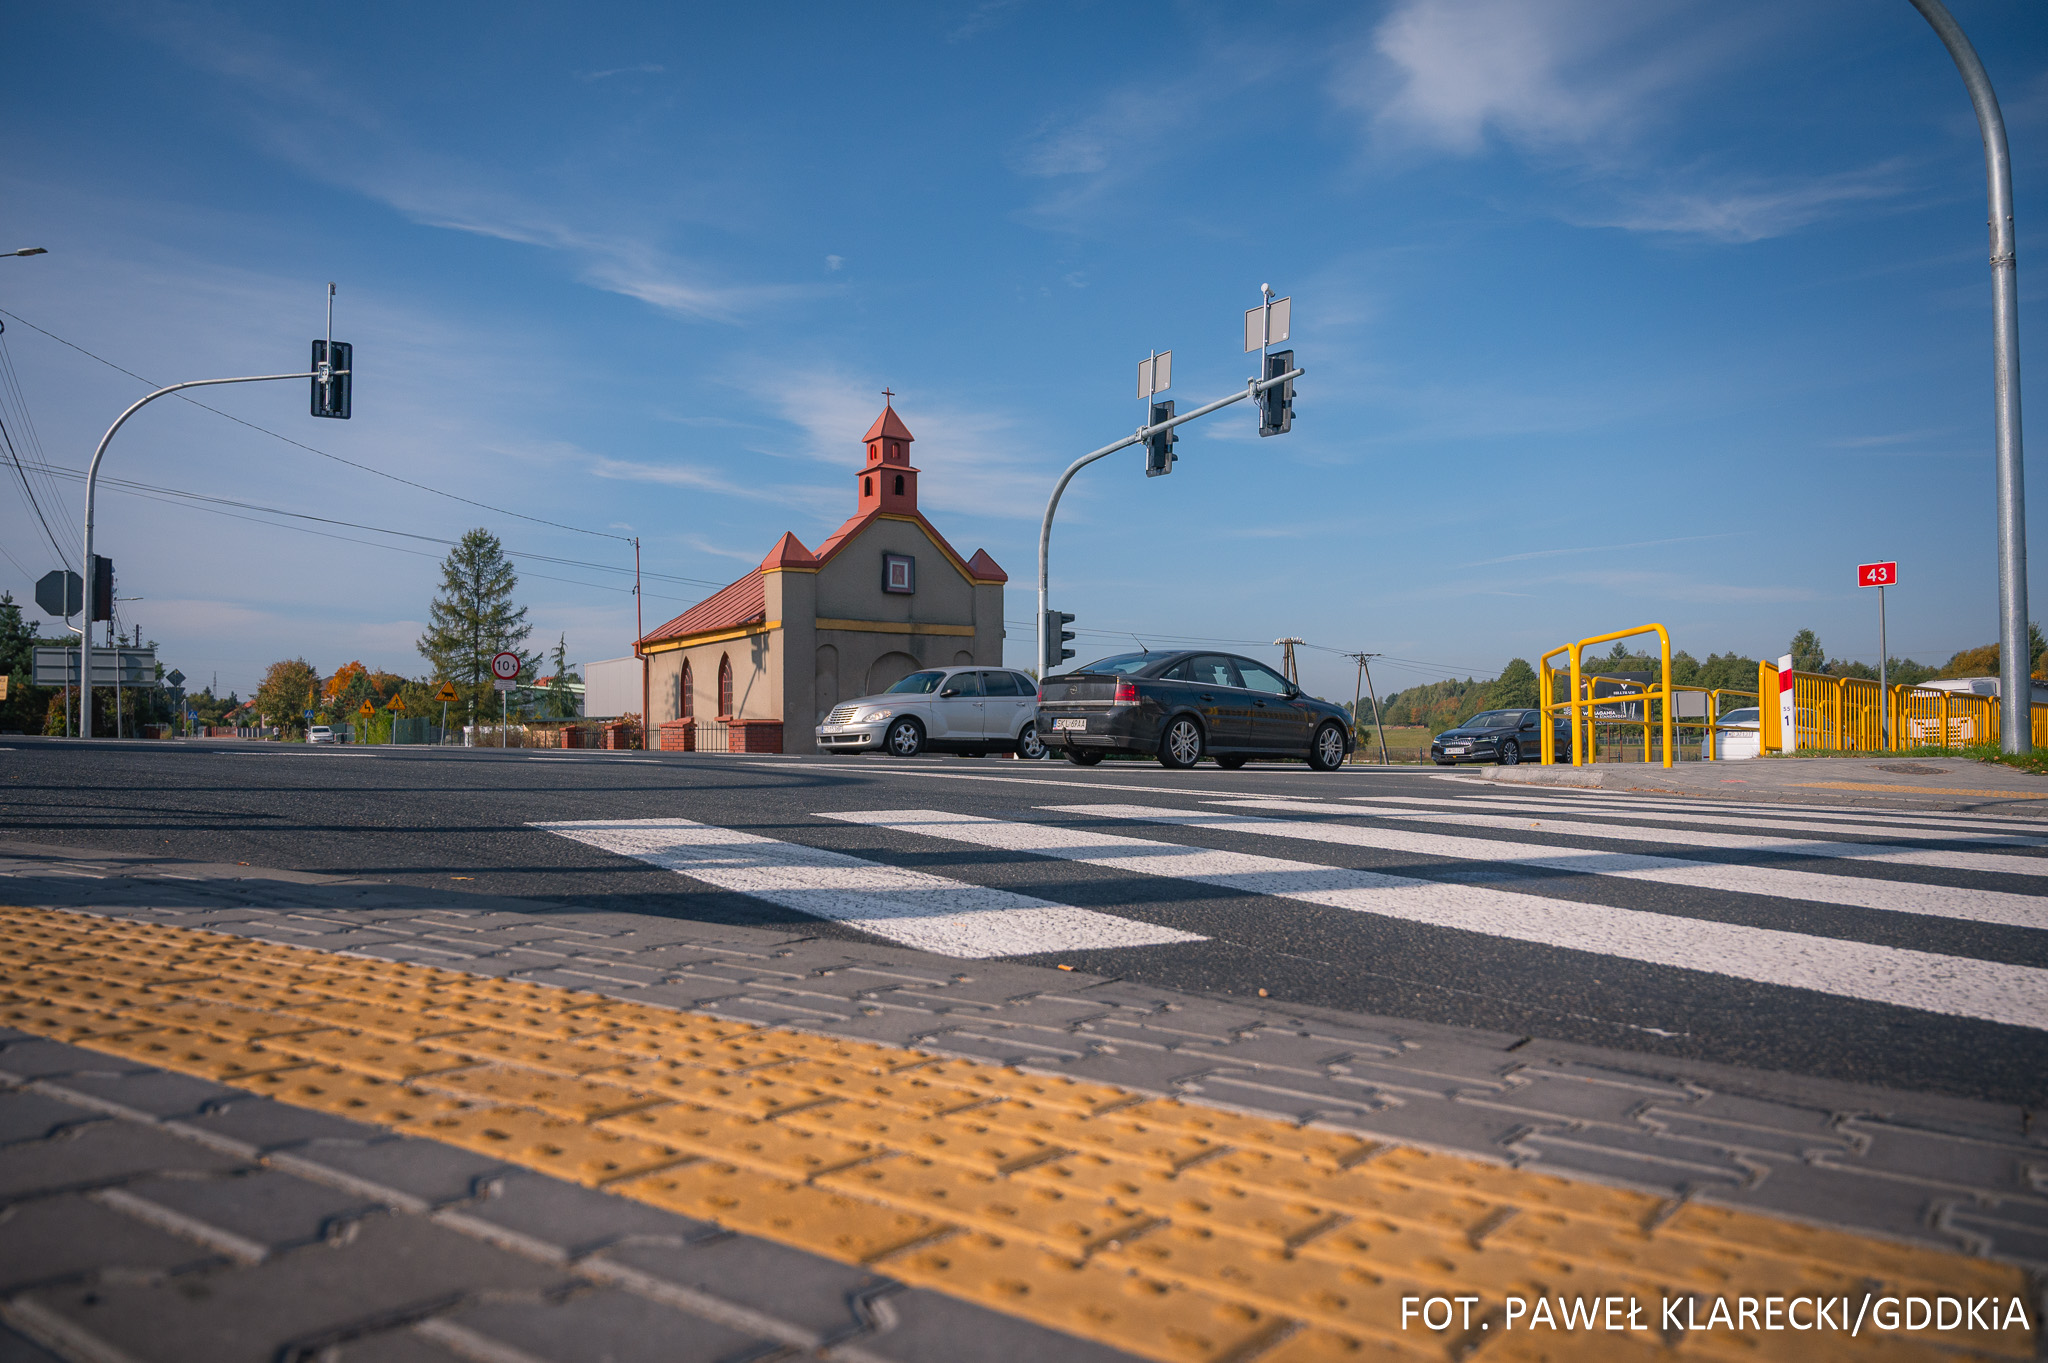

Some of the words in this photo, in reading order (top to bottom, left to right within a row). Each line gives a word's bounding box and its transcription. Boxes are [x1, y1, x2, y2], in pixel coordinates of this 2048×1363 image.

[1866, 567, 1888, 582] 43
[496, 660, 510, 671] 10
[1784, 715, 1790, 726] 1
